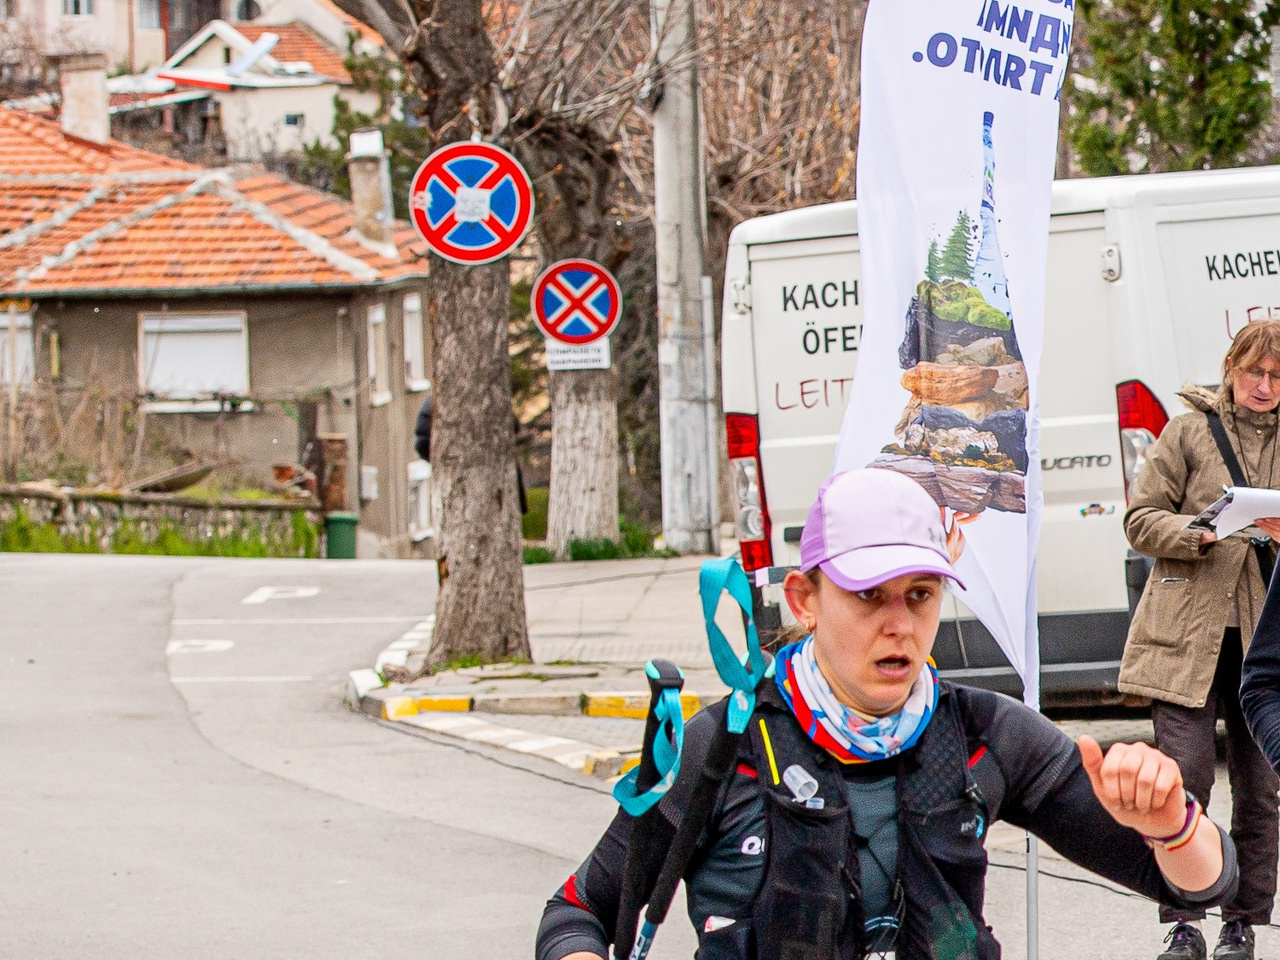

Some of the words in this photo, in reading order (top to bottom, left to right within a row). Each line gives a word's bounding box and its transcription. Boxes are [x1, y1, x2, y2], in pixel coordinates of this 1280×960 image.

[782, 280, 859, 311] KACH
[802, 321, 863, 355] ÖFE
[775, 378, 854, 410] LEIT
[1041, 455, 1111, 470] UCATO
